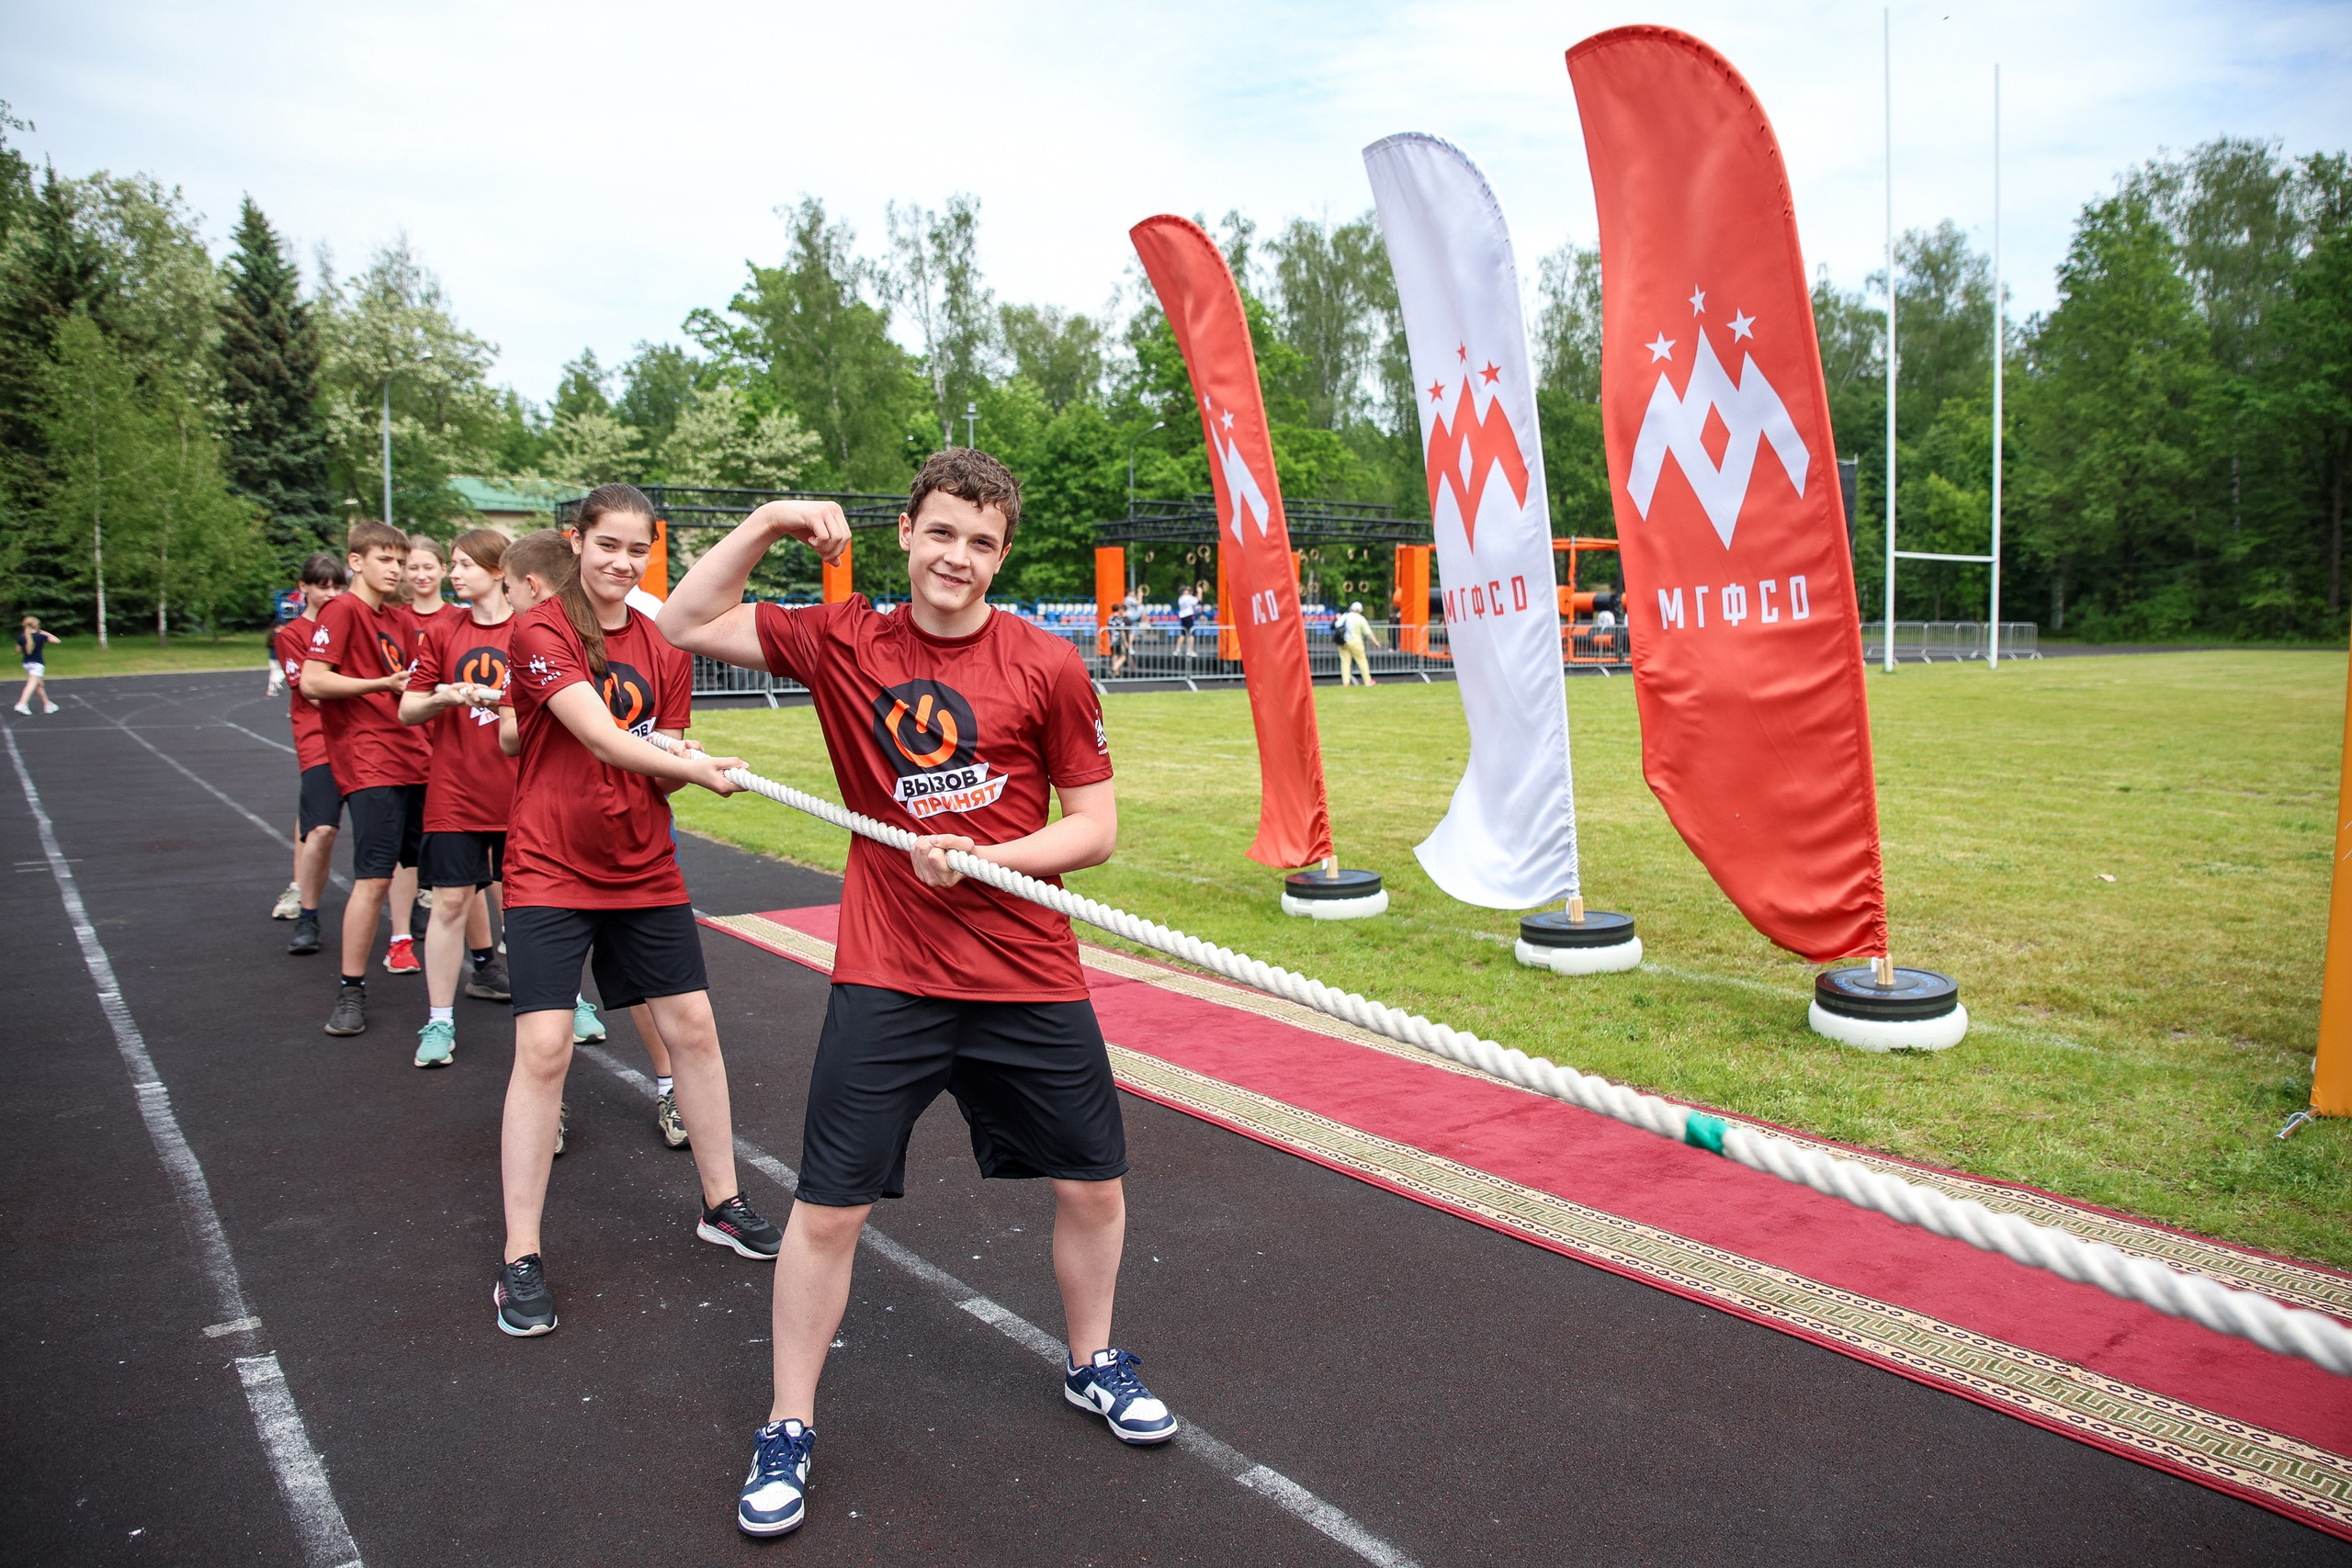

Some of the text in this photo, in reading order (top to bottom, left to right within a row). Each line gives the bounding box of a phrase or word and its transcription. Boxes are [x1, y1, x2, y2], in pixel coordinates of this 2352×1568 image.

[1657, 575, 1810, 630] МГФСО
[902, 770, 978, 797] ВЫЗОВ
[912, 784, 997, 816] ПРИНЯТ
